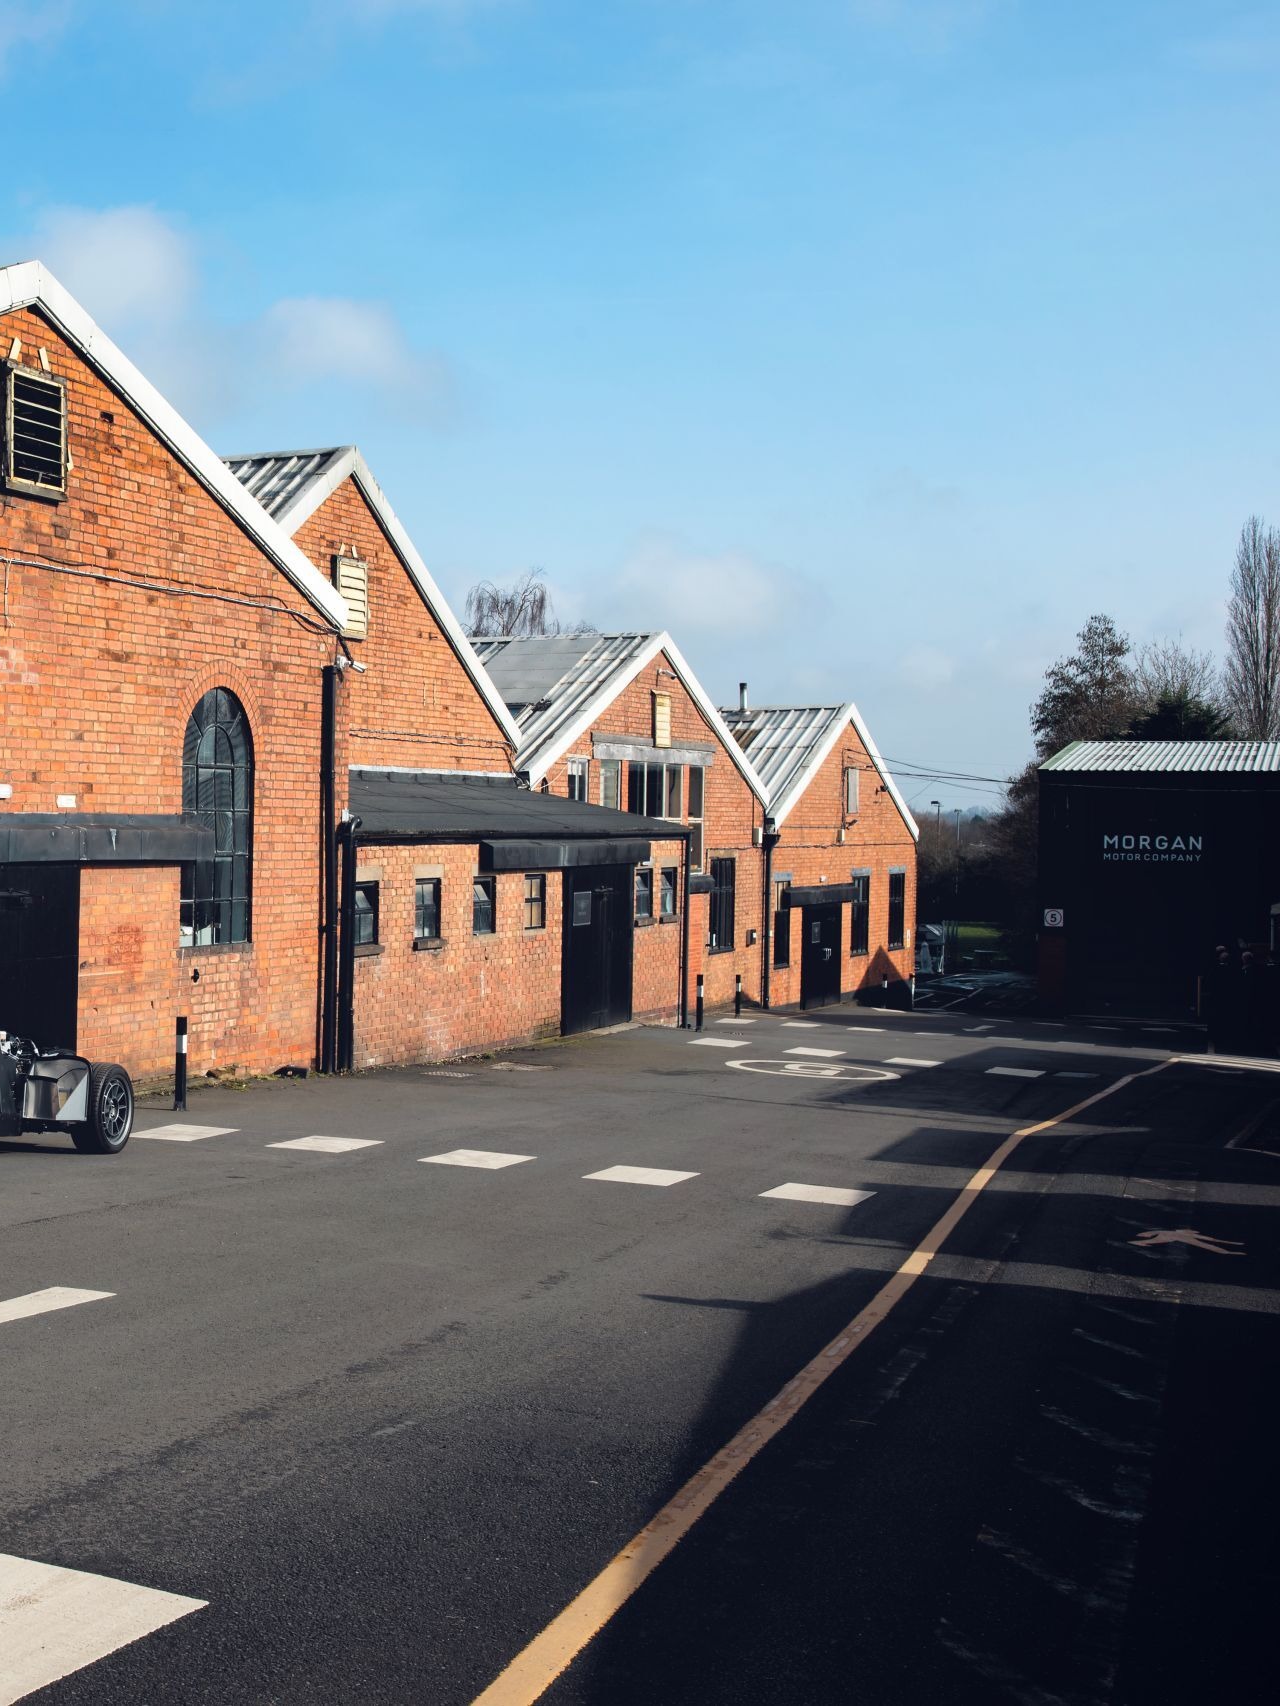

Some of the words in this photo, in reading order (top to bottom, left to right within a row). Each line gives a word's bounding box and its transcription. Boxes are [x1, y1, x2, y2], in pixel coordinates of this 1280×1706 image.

[1103, 834, 1203, 851] MORGAN
[1103, 853, 1141, 861] MOTOR
[1144, 853, 1202, 862] COMPANY
[1050, 913, 1057, 922] 5
